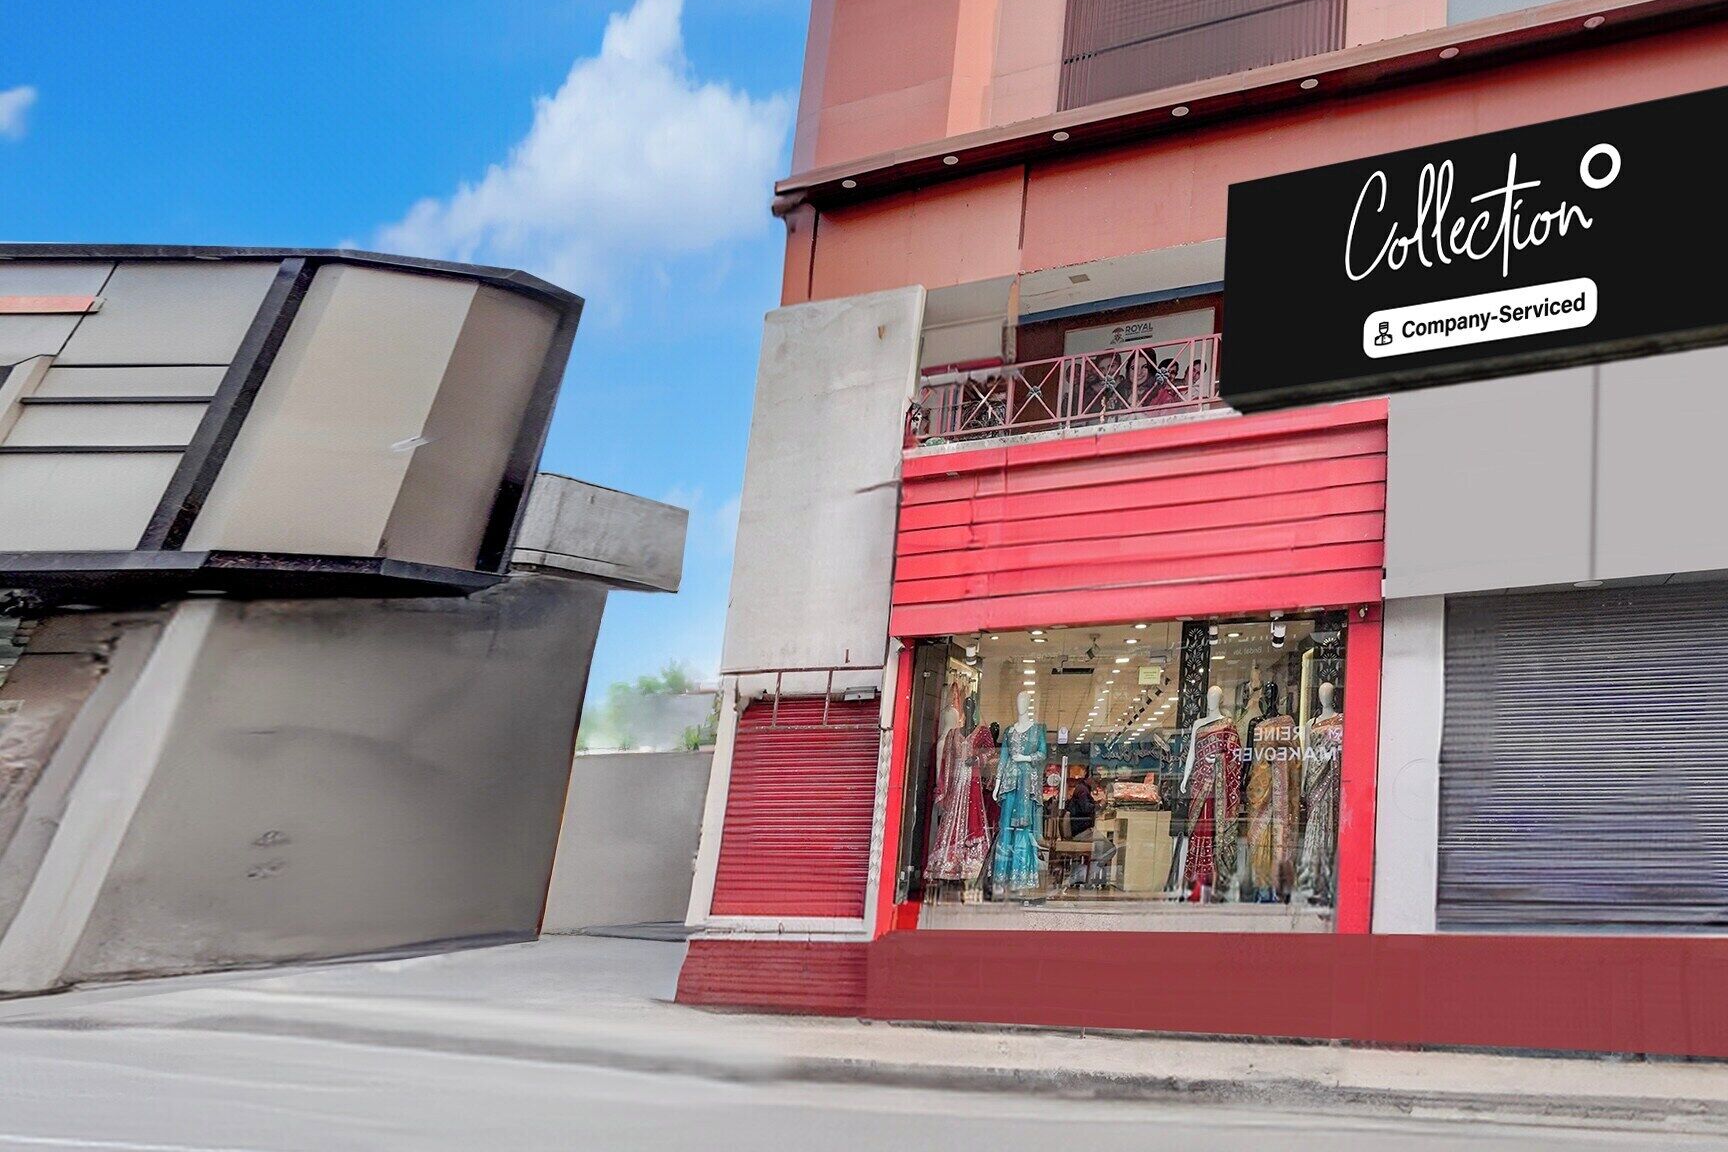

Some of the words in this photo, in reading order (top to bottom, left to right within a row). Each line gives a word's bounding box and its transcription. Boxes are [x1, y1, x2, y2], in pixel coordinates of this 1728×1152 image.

[1344, 152, 1594, 281] Collection
[1125, 322, 1153, 333] ROYAL
[1401, 291, 1586, 338] Company-Serviced
